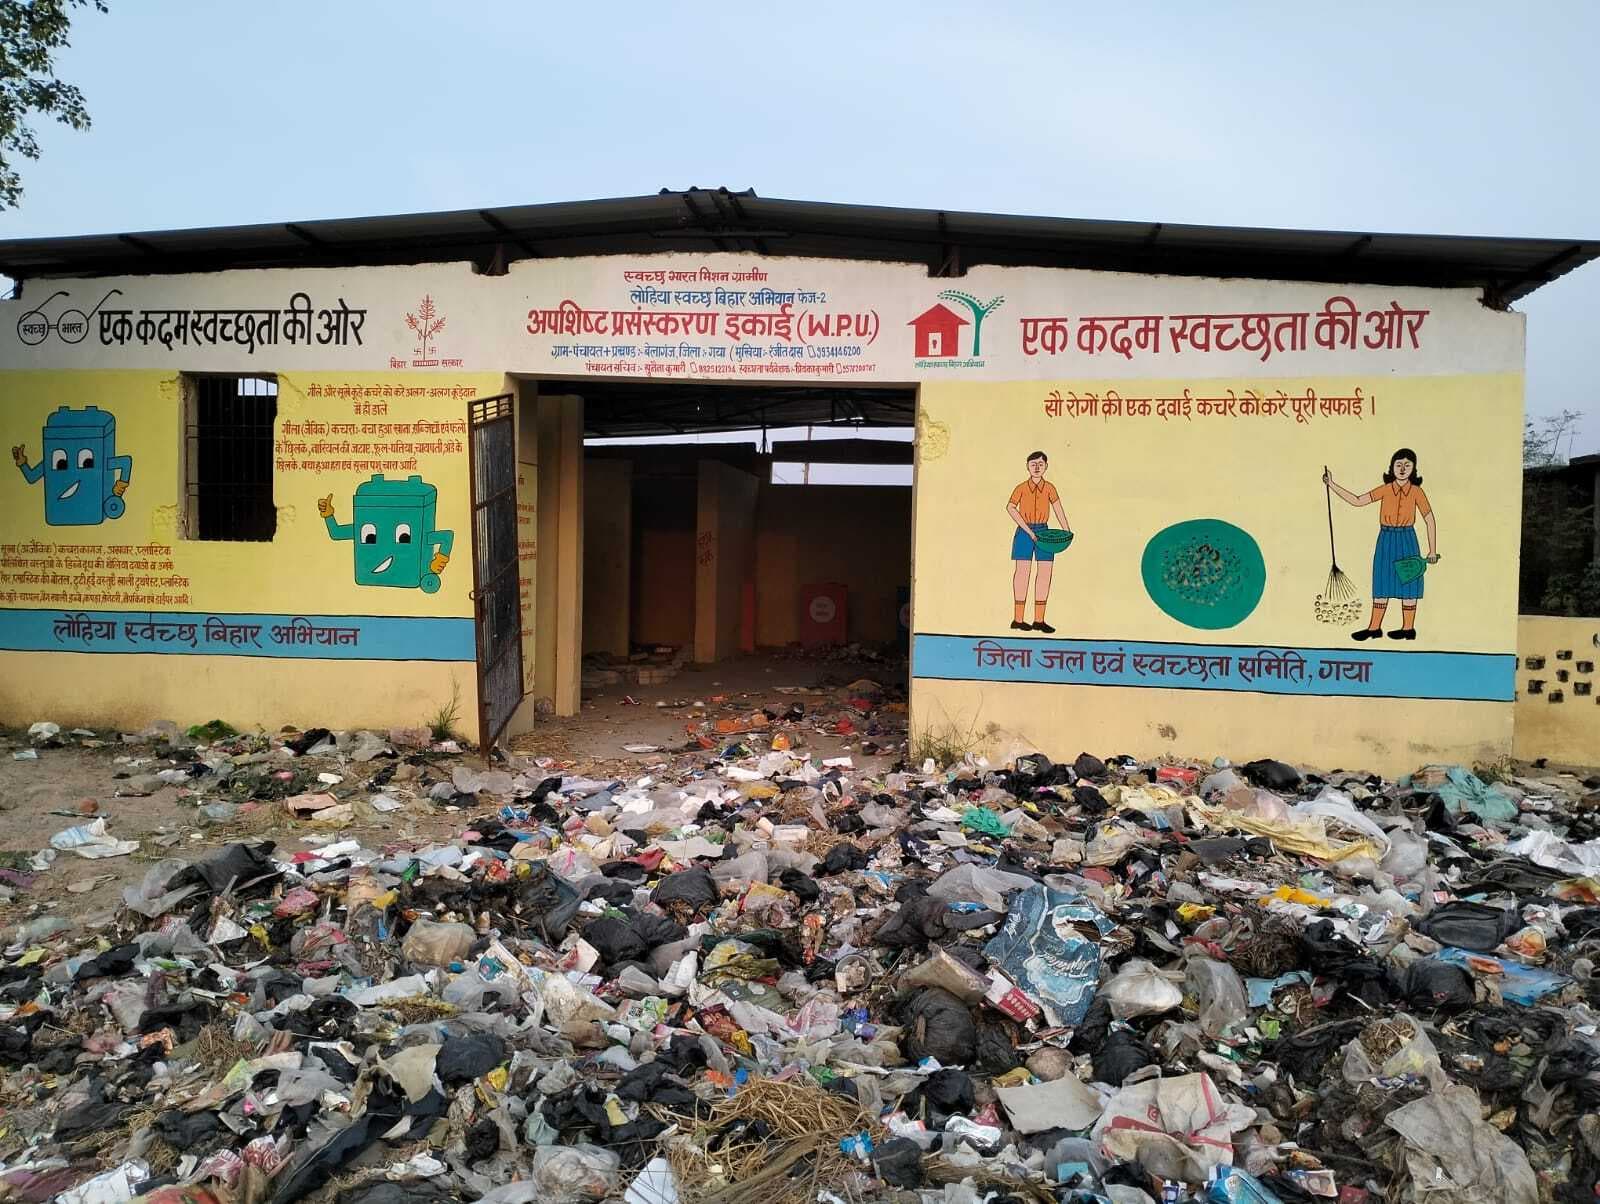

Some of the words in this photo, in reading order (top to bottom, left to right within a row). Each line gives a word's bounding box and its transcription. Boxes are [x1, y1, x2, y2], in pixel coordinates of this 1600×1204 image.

[624, 270, 666, 285] स्वच्छ
[668, 270, 697, 284] भारत
[699, 267, 729, 282] मिशन
[731, 266, 769, 284] ग्रामीण
[630, 285, 671, 306] लोहिया
[674, 290, 713, 308] स्वच्छ
[715, 286, 747, 307] बिहार
[749, 287, 796, 306] अभियान
[22, 323, 46, 337] स्वच्छ
[61, 322, 84, 335] भारत
[98, 310, 133, 346] एक
[135, 310, 191, 351] कदम
[190, 310, 281, 354] स्वच्छता
[282, 292, 314, 346] की
[315, 298, 367, 346] ओर
[526, 300, 608, 337] अपशिष्ट
[610, 306, 720, 337] प्रसंस्करण
[724, 303, 795, 342] इकाई
[1020, 317, 1068, 356] एक
[1077, 315, 1164, 360] कदम
[1168, 312, 1310, 362] स्वच्छता
[1314, 296, 1361, 350] की
[1363, 301, 1430, 349] ओर
[307, 383, 322, 397] गीले
[323, 384, 337, 398] और
[1043, 390, 1065, 418] सौ
[1066, 391, 1100, 419] रोगों
[1101, 389, 1123, 420] की
[1125, 398, 1153, 416] एक
[1155, 388, 1193, 421] दवाई
[1196, 389, 1237, 417] कचरे
[1238, 390, 1261, 416] को
[1261, 390, 1289, 418] करें
[1290, 387, 1318, 425] पूरी
[1319, 386, 1364, 420] सफाई
[281, 420, 301, 435] गीला
[52, 612, 117, 644] लोहिया
[124, 622, 198, 648] स्वच्छ
[203, 616, 262, 649] बिहार
[271, 617, 361, 647] अभियान
[972, 640, 1033, 670] जिला
[1038, 649, 1086, 671] जल
[1092, 647, 1127, 674] एवं
[1132, 654, 1232, 682] स्वच्छता
[1318, 659, 1373, 683] गया
